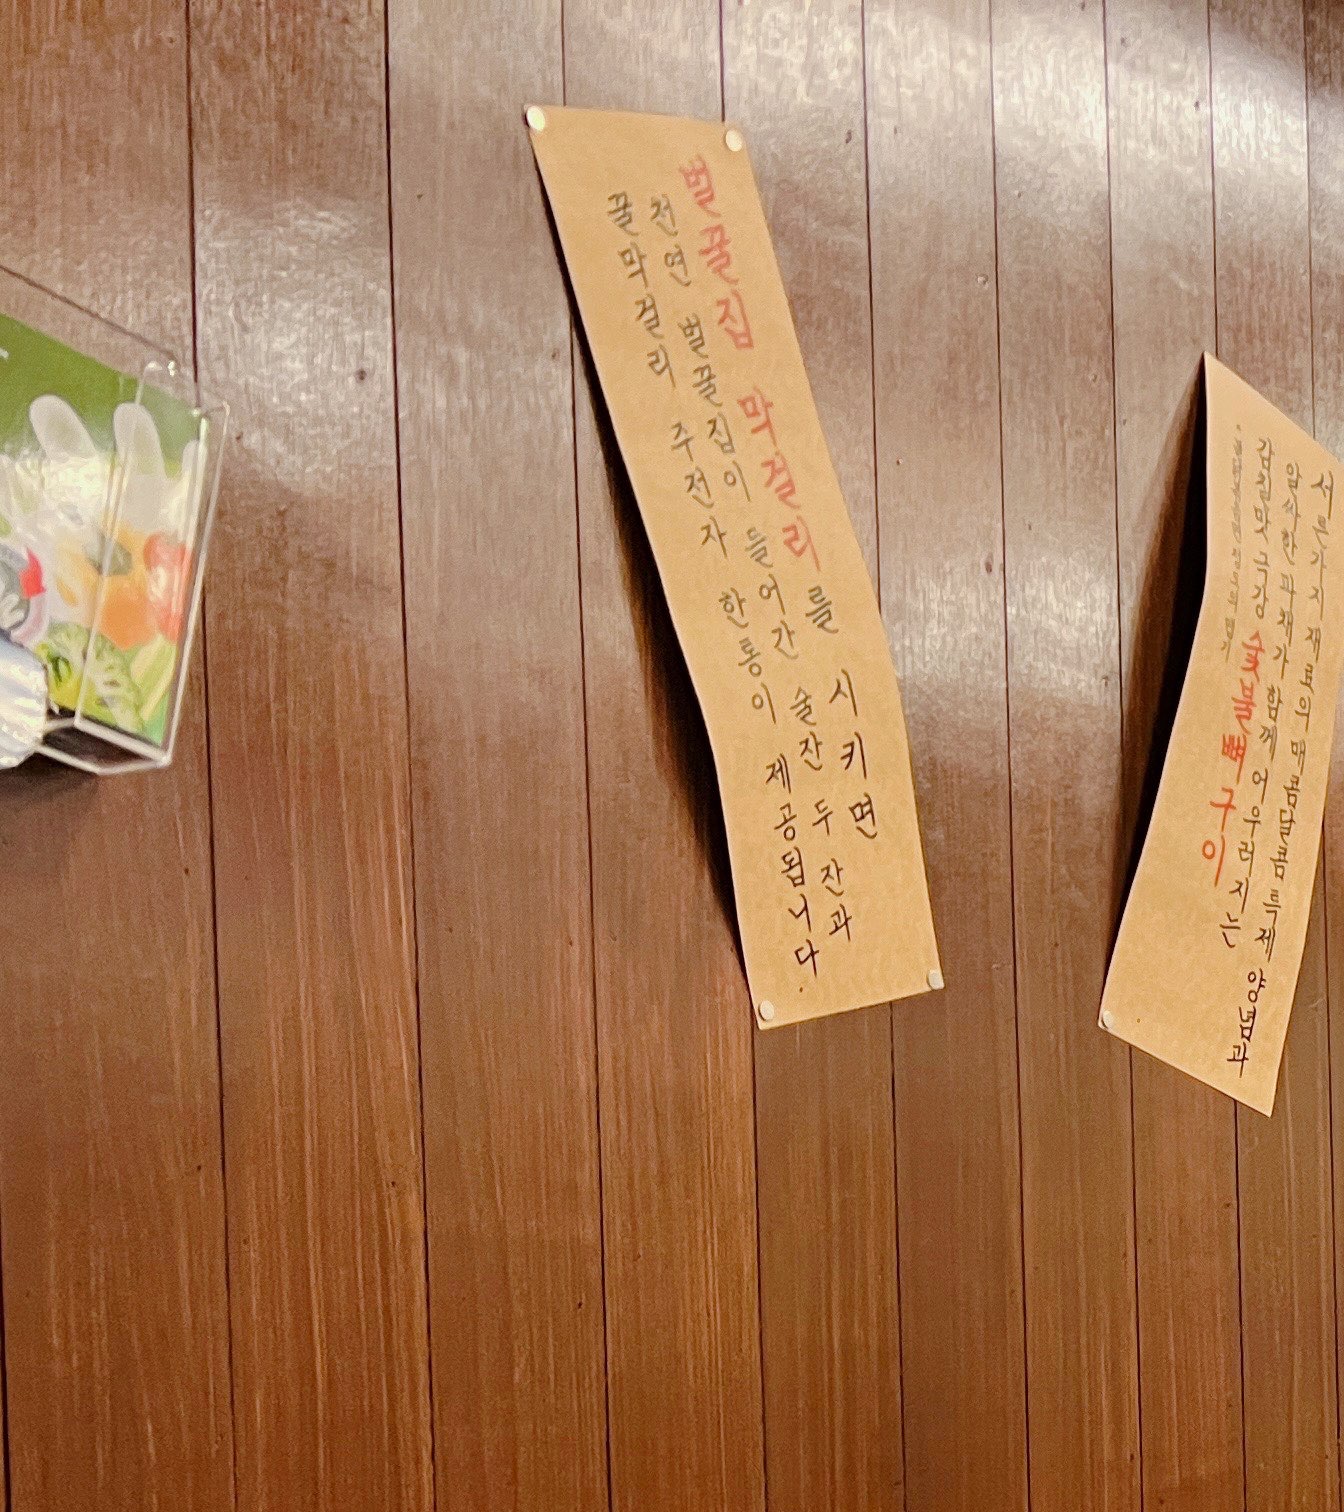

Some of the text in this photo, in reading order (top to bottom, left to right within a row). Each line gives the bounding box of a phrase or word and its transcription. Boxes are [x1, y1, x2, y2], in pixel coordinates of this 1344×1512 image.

[607, 191, 676, 389] 꿀막걸리
[670, 422, 728, 559] 주전자
[718, 586, 776, 724] 한통이
[679, 155, 754, 350] 벌꿀집
[828, 668, 877, 839] 시키면
[1253, 437, 1275, 544] 감칠맛
[650, 193, 854, 942] 천연 벌꿀집이 들어간 술잔 두 잔과
[1273, 572, 1297, 681] 파채가
[1259, 684, 1283, 762] 함께
[1294, 626, 1322, 734] 재료의
[1201, 630, 1265, 888] 숯불뼈구이
[1270, 738, 1306, 881] 매콤달콤
[1219, 767, 1268, 949] 어우러지는
[1254, 888, 1281, 963] 특제
[1226, 967, 1267, 1078] 양념과
